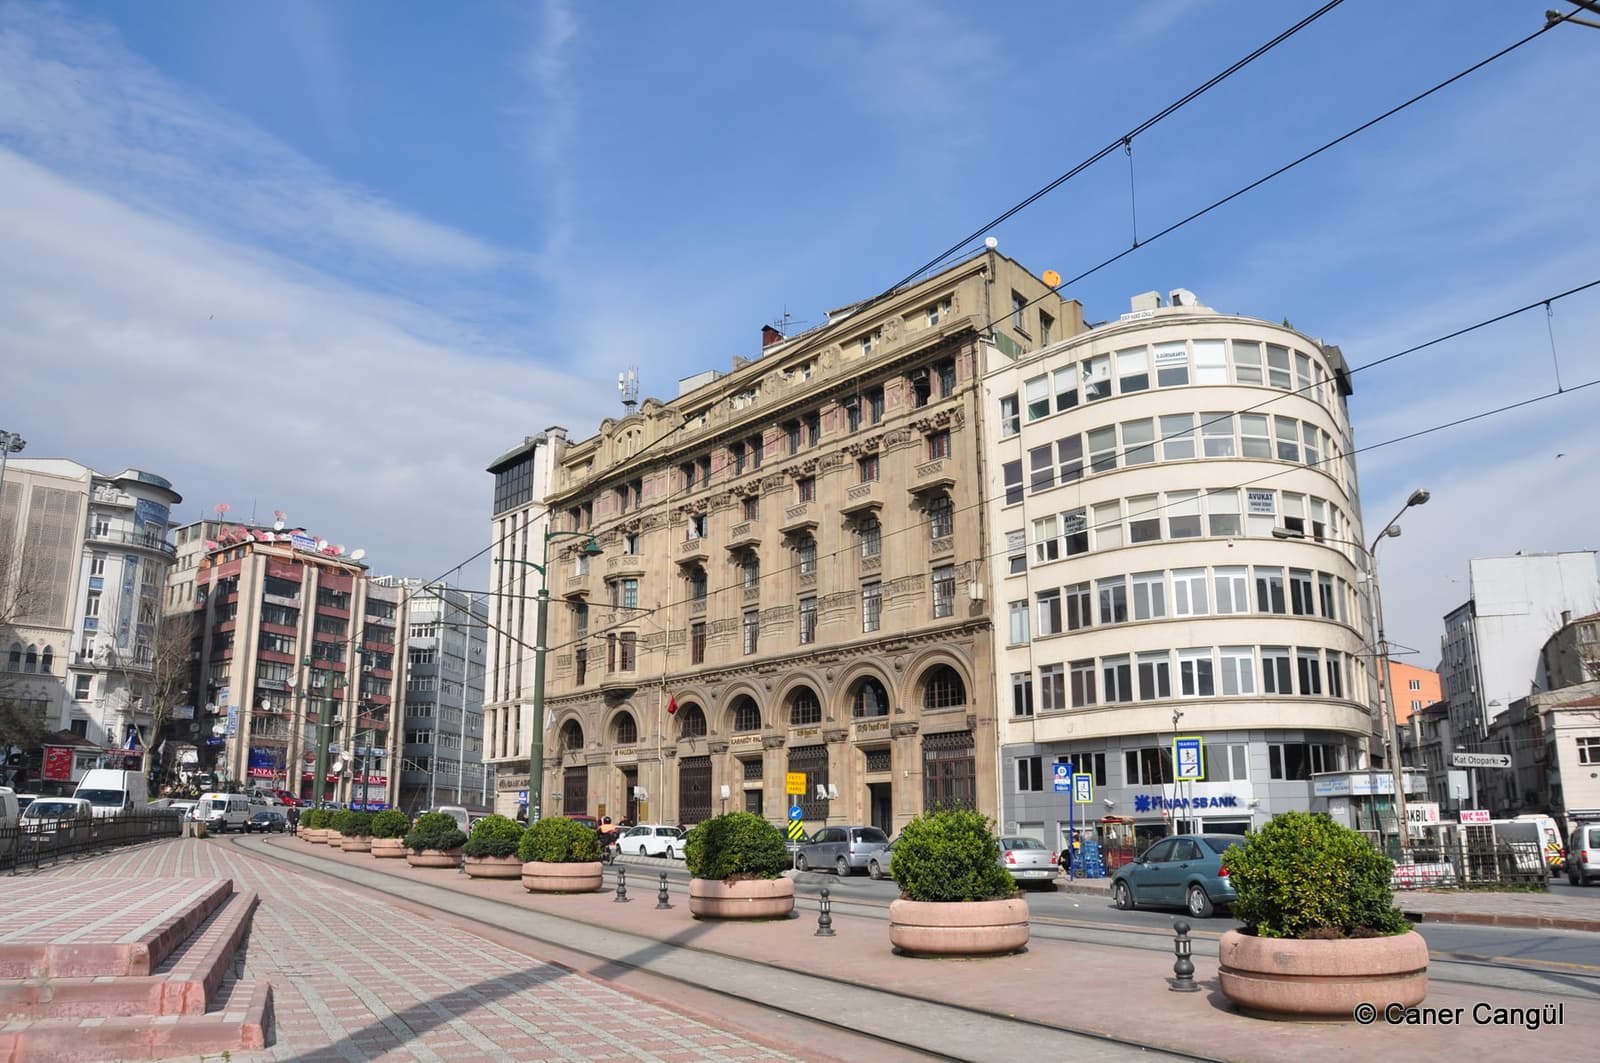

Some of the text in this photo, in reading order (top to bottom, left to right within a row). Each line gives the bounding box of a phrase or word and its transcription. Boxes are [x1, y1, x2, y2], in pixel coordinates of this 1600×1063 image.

[1454, 755, 1467, 764] Kat
[1151, 795, 1238, 810] FINANSBANK
[1460, 812, 1473, 821] WC
